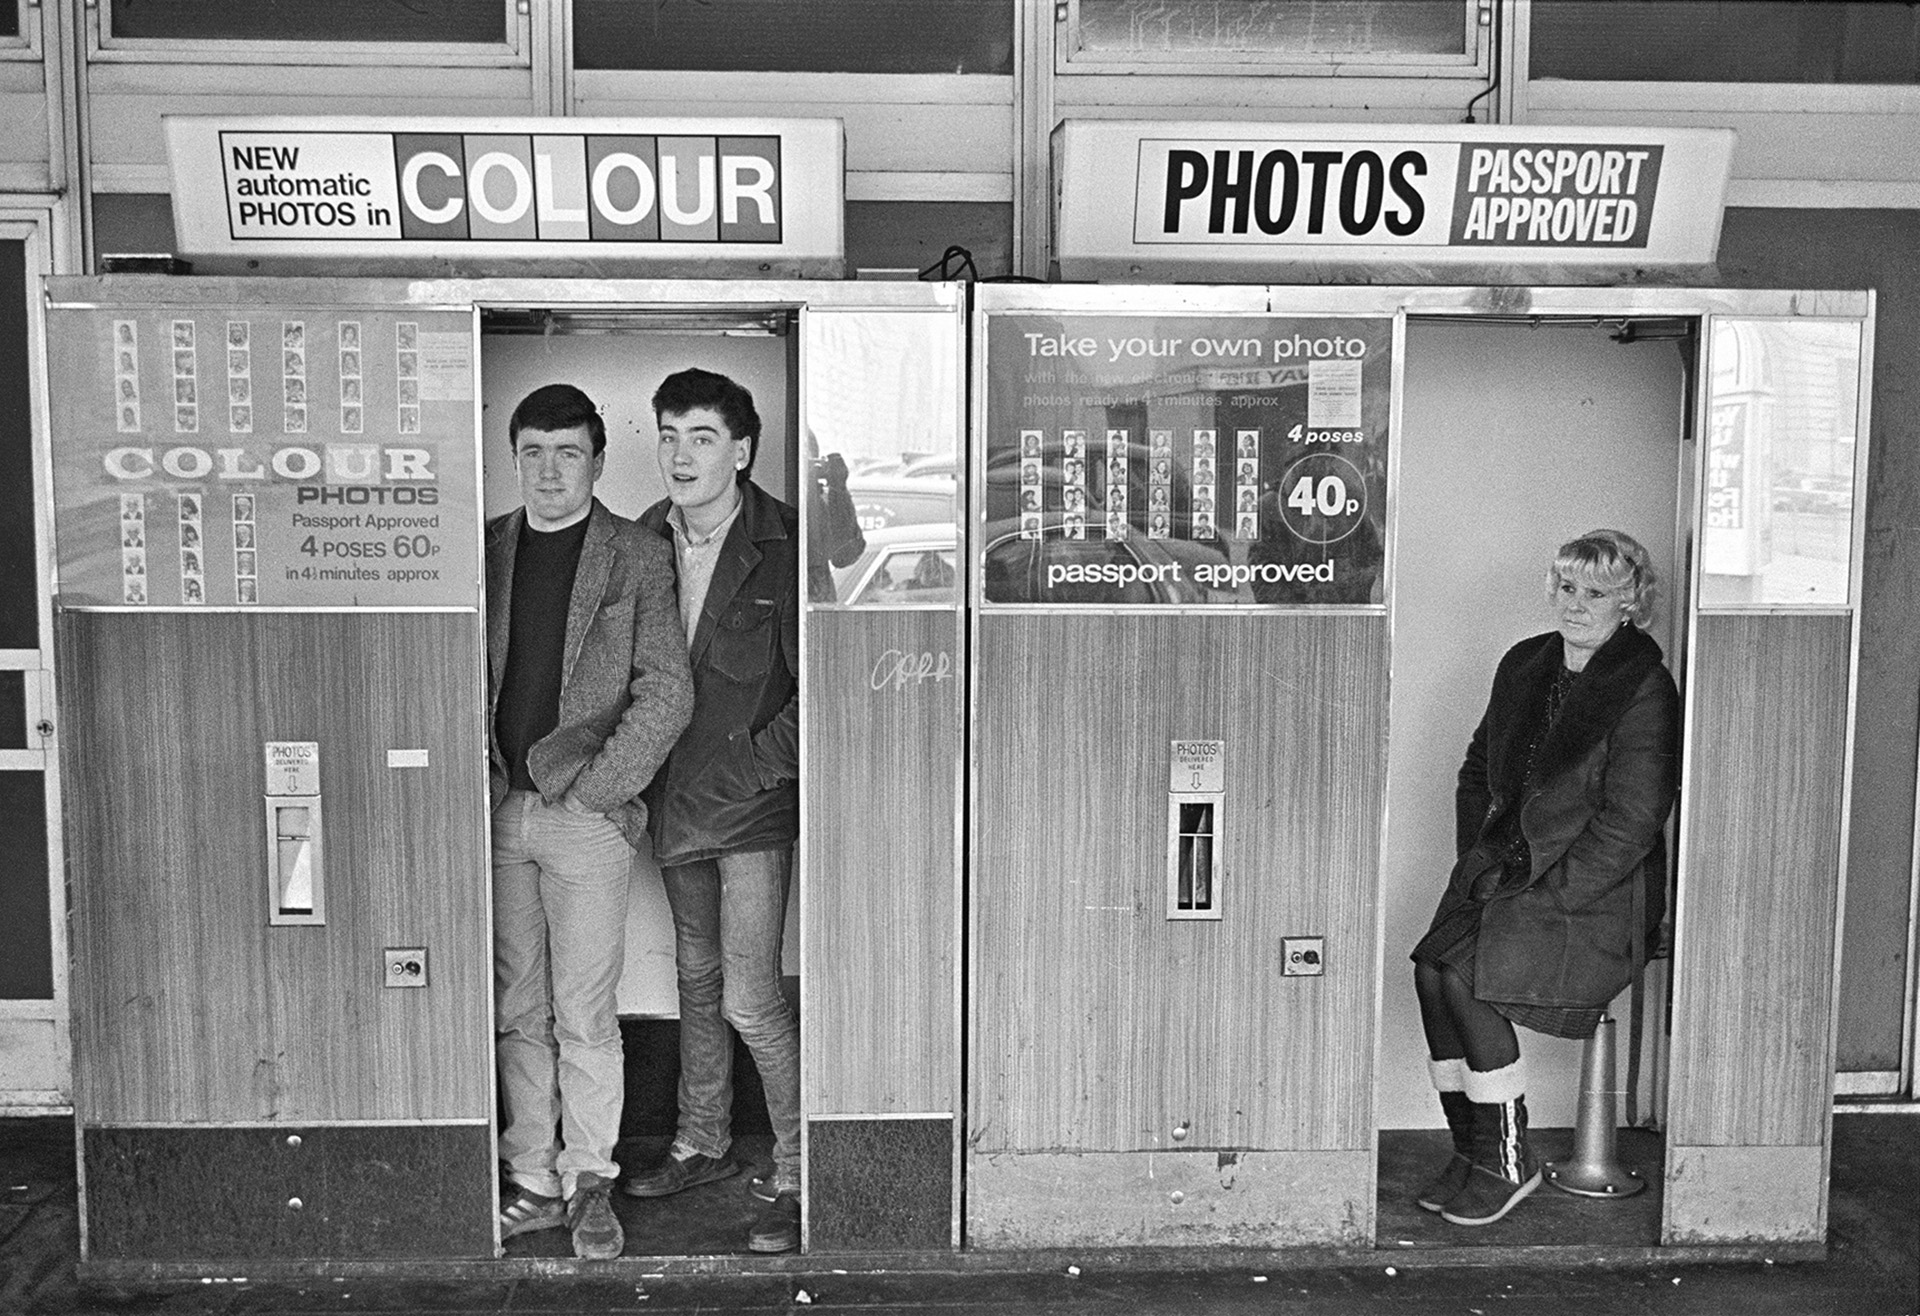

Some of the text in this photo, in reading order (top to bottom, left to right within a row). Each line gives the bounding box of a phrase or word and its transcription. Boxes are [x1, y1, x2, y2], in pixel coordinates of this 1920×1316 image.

[232, 146, 299, 171] NEW
[1467, 148, 1648, 195] PASSPORT
[236, 173, 371, 198] automatic
[401, 151, 777, 226] COLOUR
[1163, 149, 1428, 236] PHOTOS
[239, 201, 391, 227] PHOTOS in
[1464, 197, 1637, 243] APPROVED
[1024, 333, 1366, 363] Take your own photo
[1024, 371, 1056, 384] with
[1064, 370, 1088, 384] the
[1023, 393, 1072, 407] photos
[1080, 394, 1119, 408] ready
[1125, 394, 1138, 405] in
[1231, 396, 1279, 408] approx
[1287, 424, 1364, 445] 4 poses
[104, 447, 436, 480] COLOUR
[298, 487, 439, 505] PHOTOS
[1288, 475, 1359, 516] 40p
[292, 514, 439, 530] Passport Approved
[300, 536, 319, 557] 4
[323, 541, 387, 558] POSES
[285, 565, 299, 580] in
[319, 566, 381, 581] minutes
[387, 569, 440, 583] approx
[1047, 559, 1334, 587] passport approved
[272, 746, 311, 758] PHOTOS
[1177, 743, 1217, 755] PHOTOS
